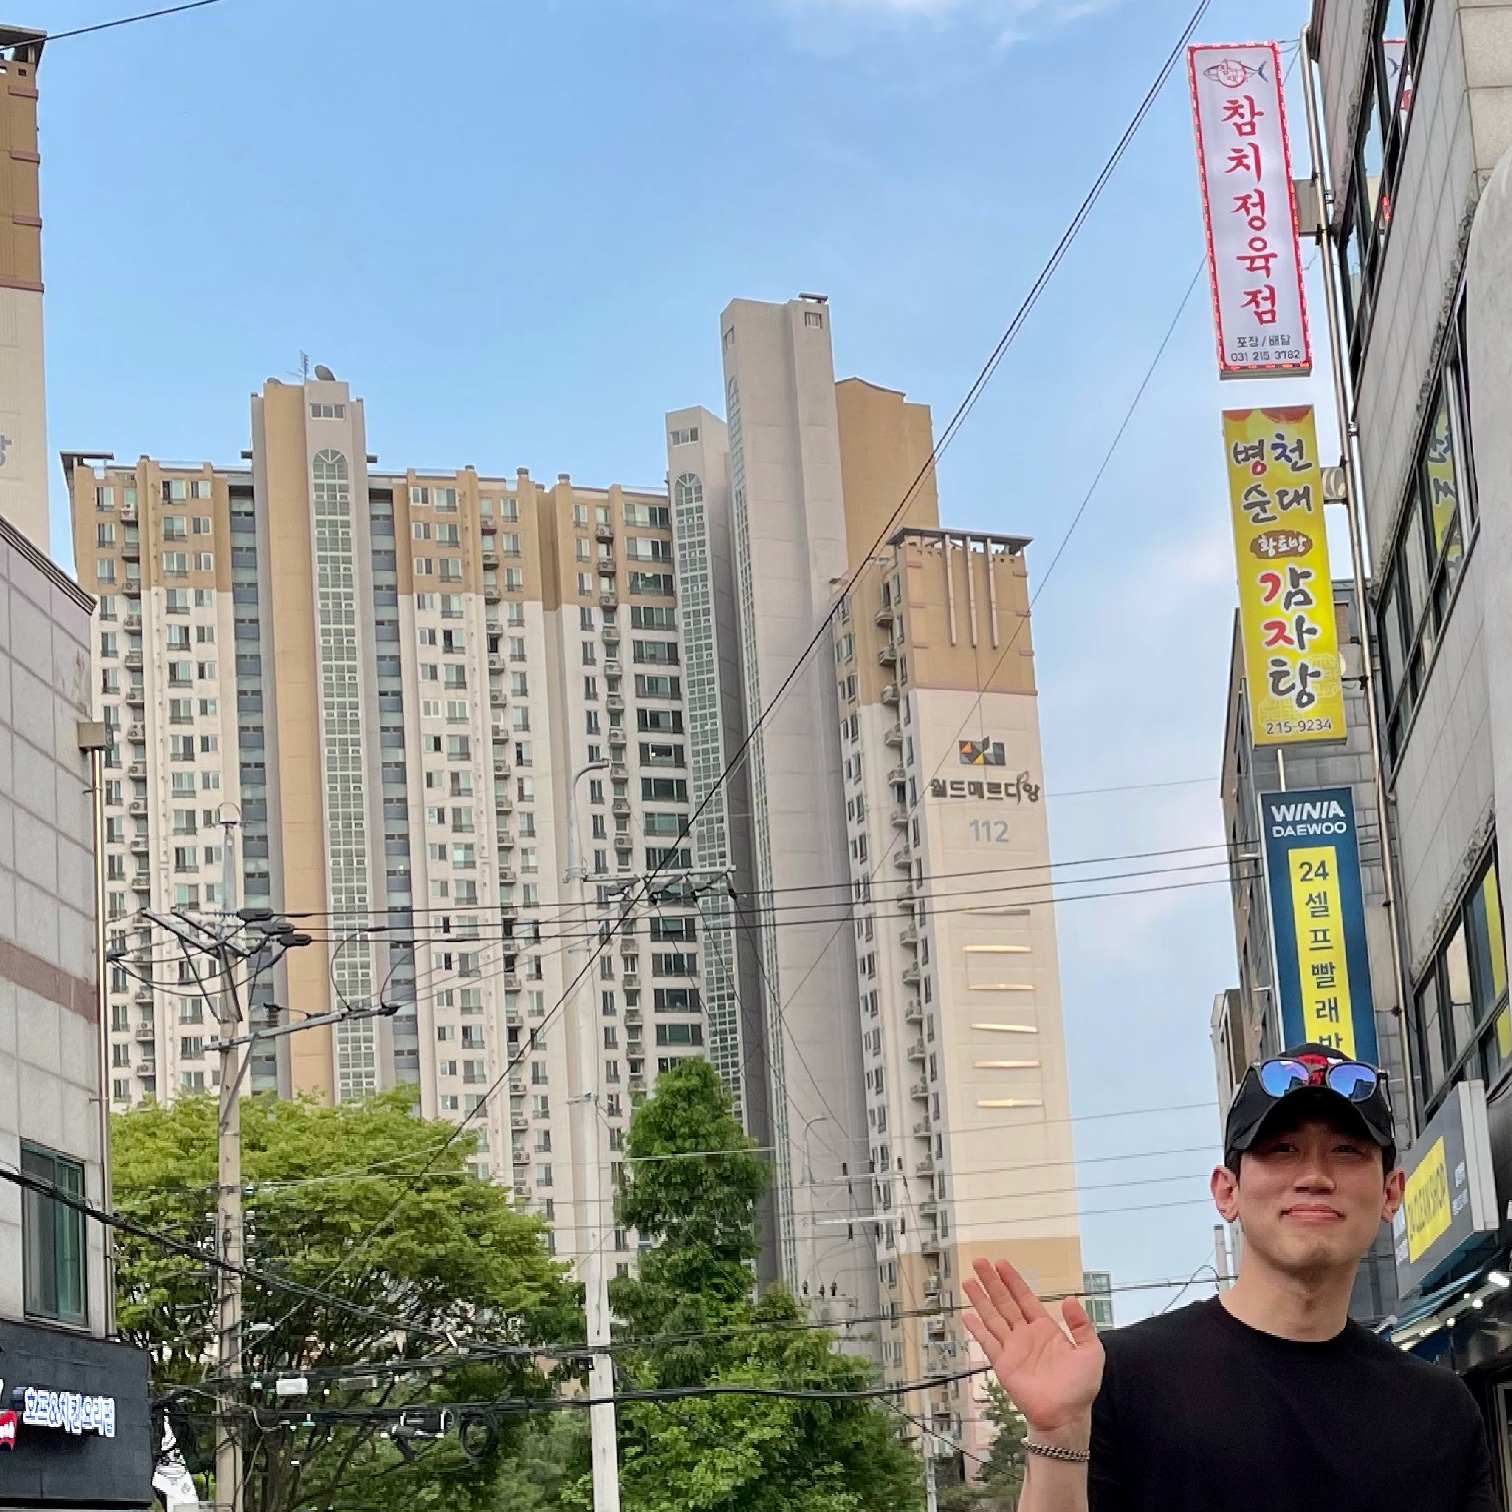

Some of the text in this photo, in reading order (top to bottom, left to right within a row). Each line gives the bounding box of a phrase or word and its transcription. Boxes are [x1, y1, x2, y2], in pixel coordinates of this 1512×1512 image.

[1221, 95, 1278, 326] 참치정육점
[1231, 349, 1300, 362] 031 215 3782
[1233, 433, 1312, 476] 명천
[1243, 484, 1312, 523] 순대
[1260, 567, 1320, 709] 감자탕
[1266, 720, 1332, 735] 215-9234
[931, 771, 1040, 805] 월드메르디앙
[1271, 800, 1346, 822] WINIA
[969, 819, 1009, 843] 112
[1272, 821, 1347, 838] DAEWOO
[1299, 860, 1330, 883] 24
